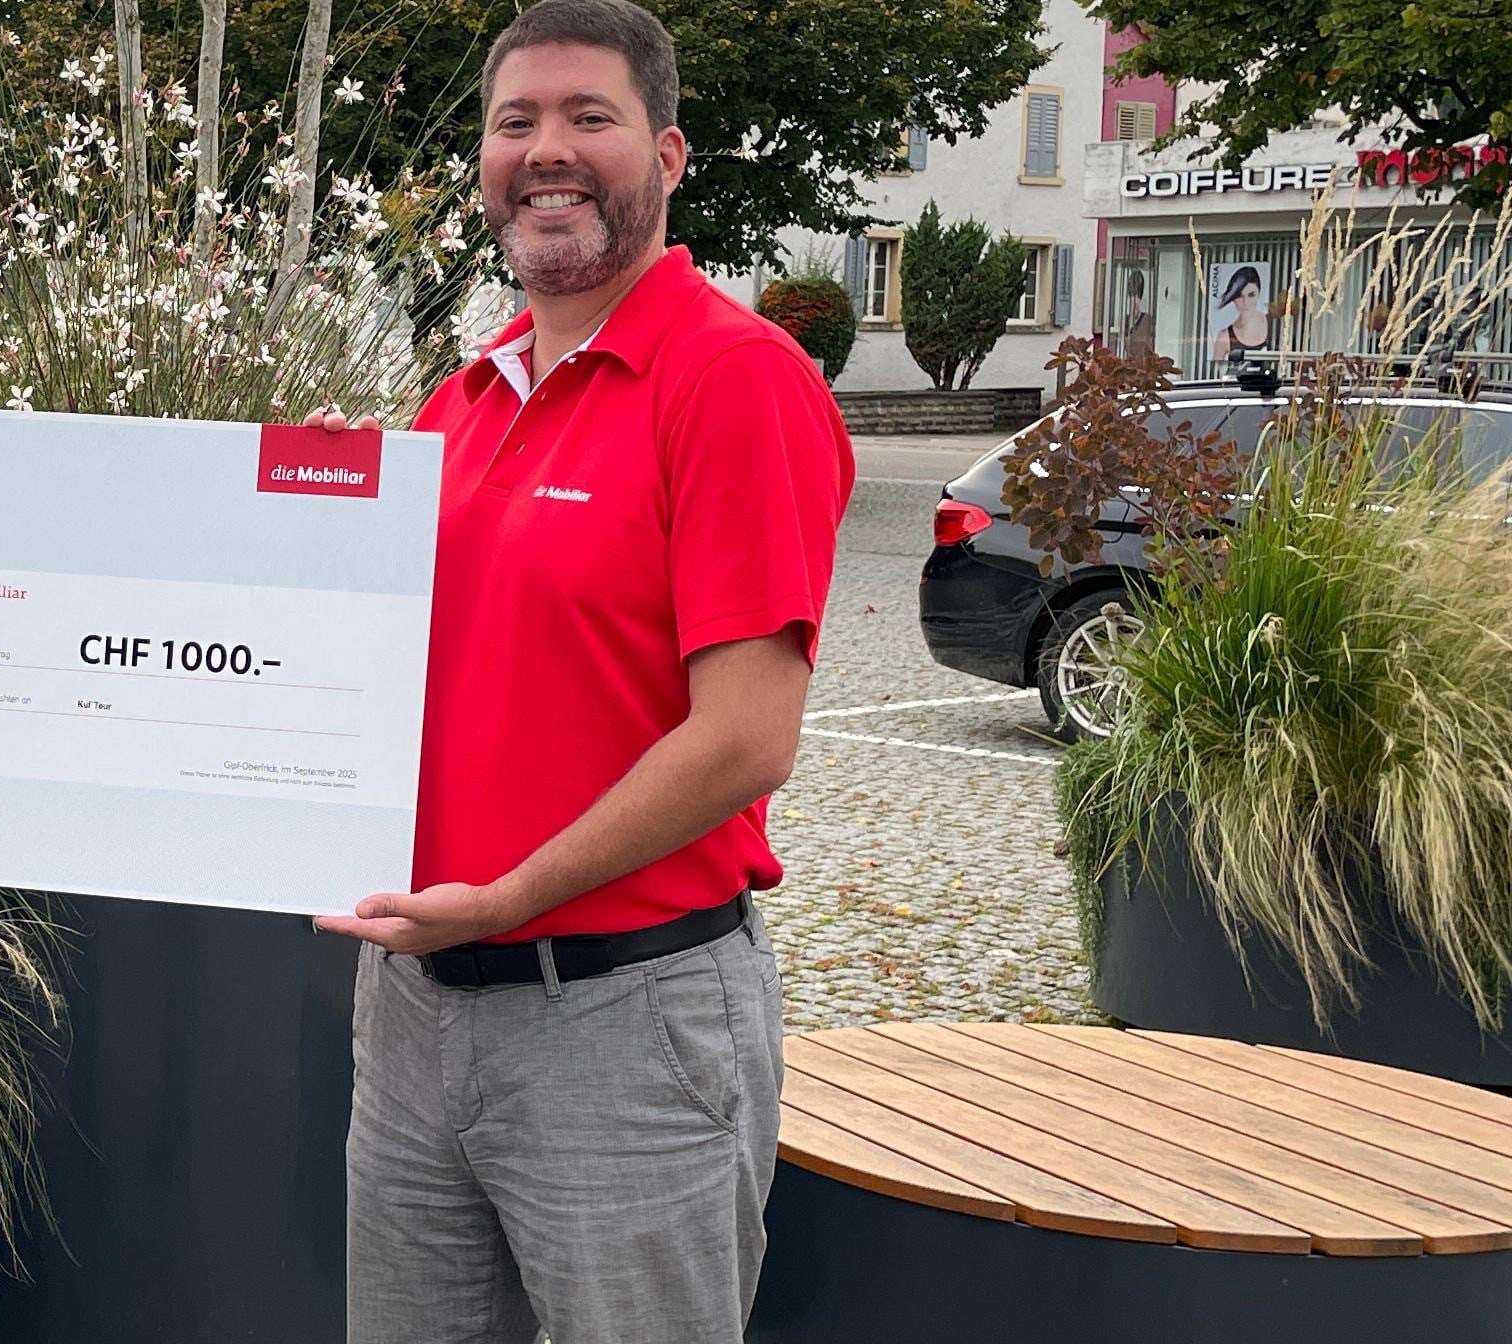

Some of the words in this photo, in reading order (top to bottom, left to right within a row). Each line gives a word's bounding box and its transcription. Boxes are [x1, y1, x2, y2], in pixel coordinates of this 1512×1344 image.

[1120, 165, 1334, 198] COIFFURE
[270, 464, 295, 481] die
[296, 466, 366, 485] Mobiliar
[79, 634, 151, 667] CHF
[293, 766, 335, 777] September
[337, 768, 358, 778] 2025
